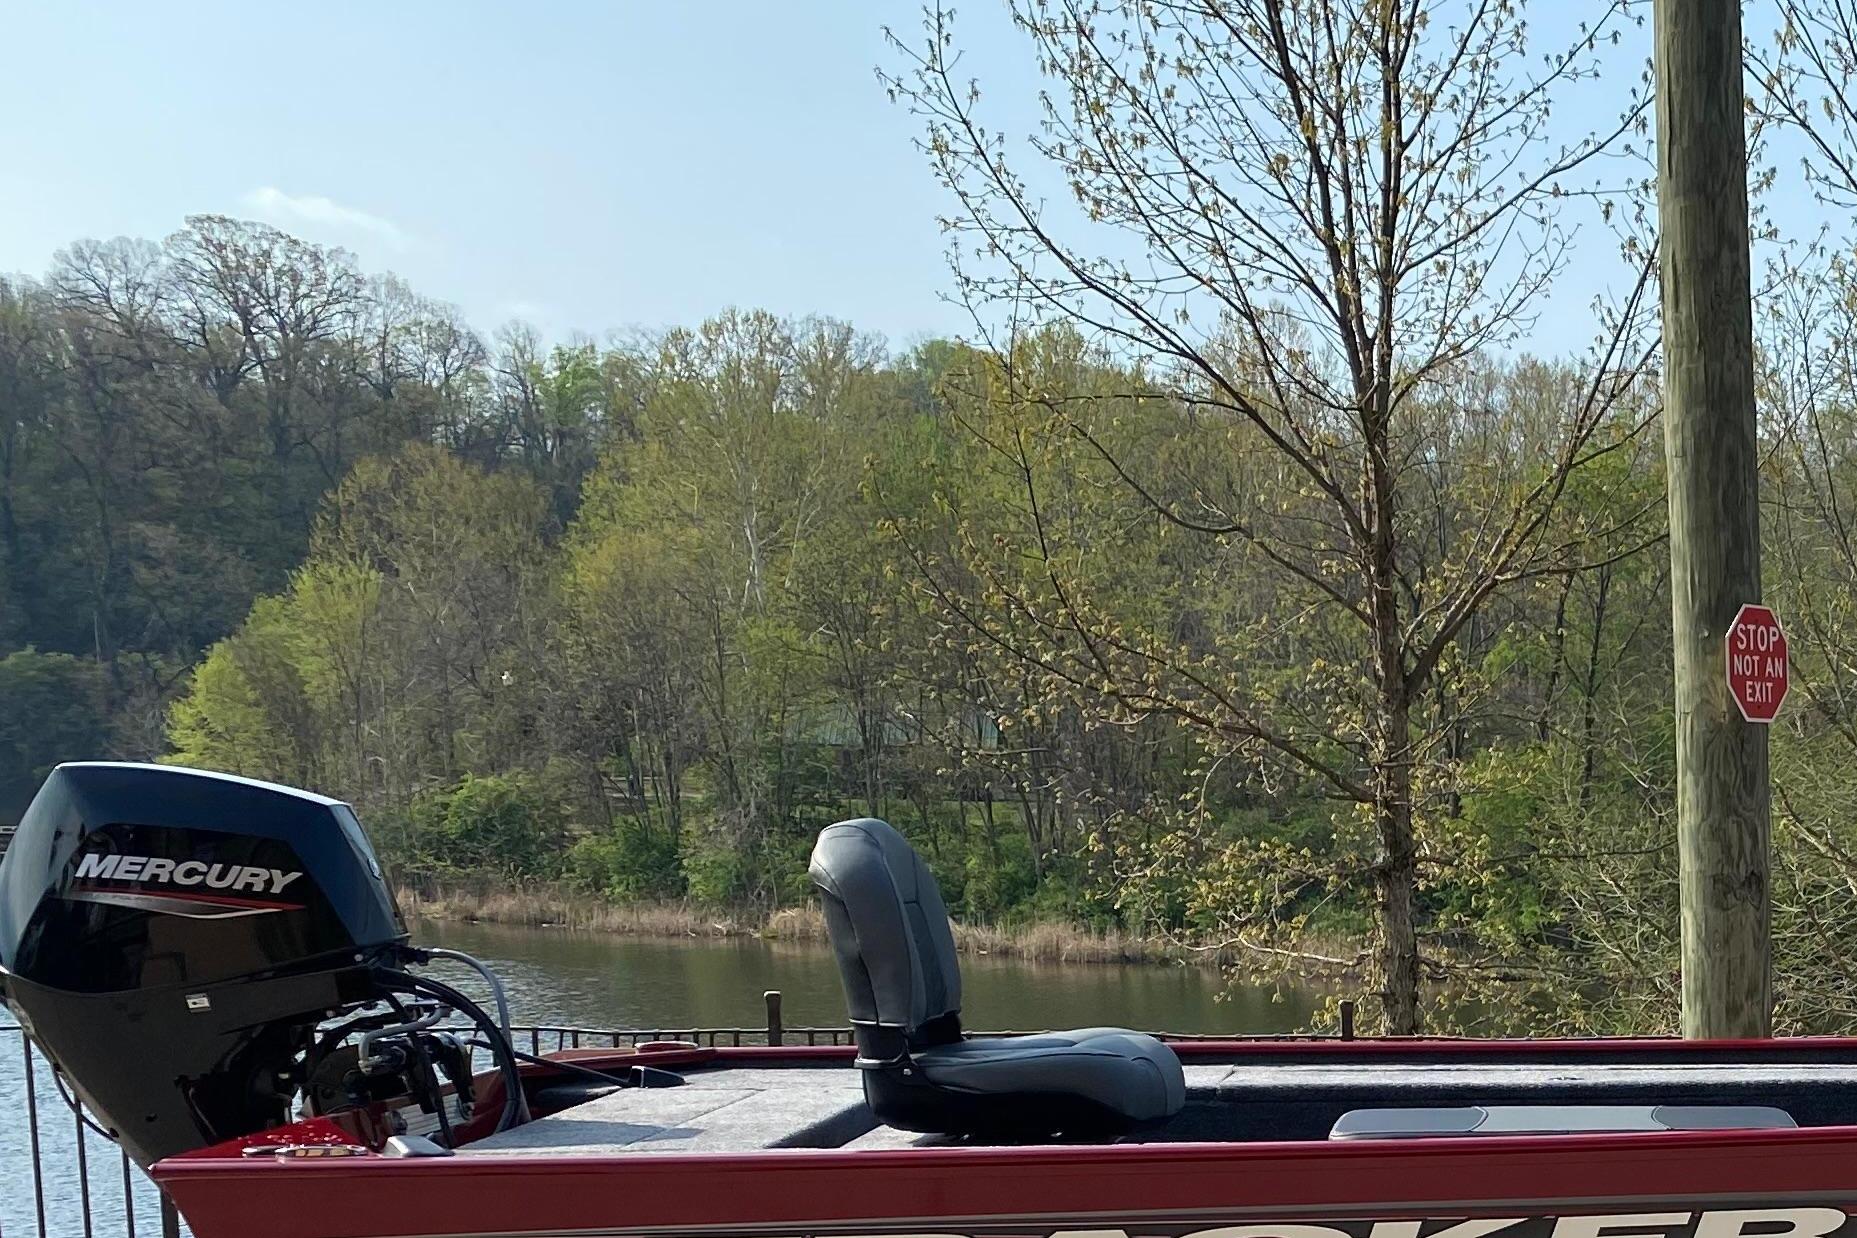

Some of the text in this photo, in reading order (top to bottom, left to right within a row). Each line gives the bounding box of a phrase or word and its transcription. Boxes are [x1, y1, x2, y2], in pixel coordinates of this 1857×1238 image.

[1736, 623, 1780, 652] STOP
[1733, 654, 1783, 679] NOT AN
[1746, 681, 1774, 704] EXIT
[75, 853, 303, 894] MERCURY
